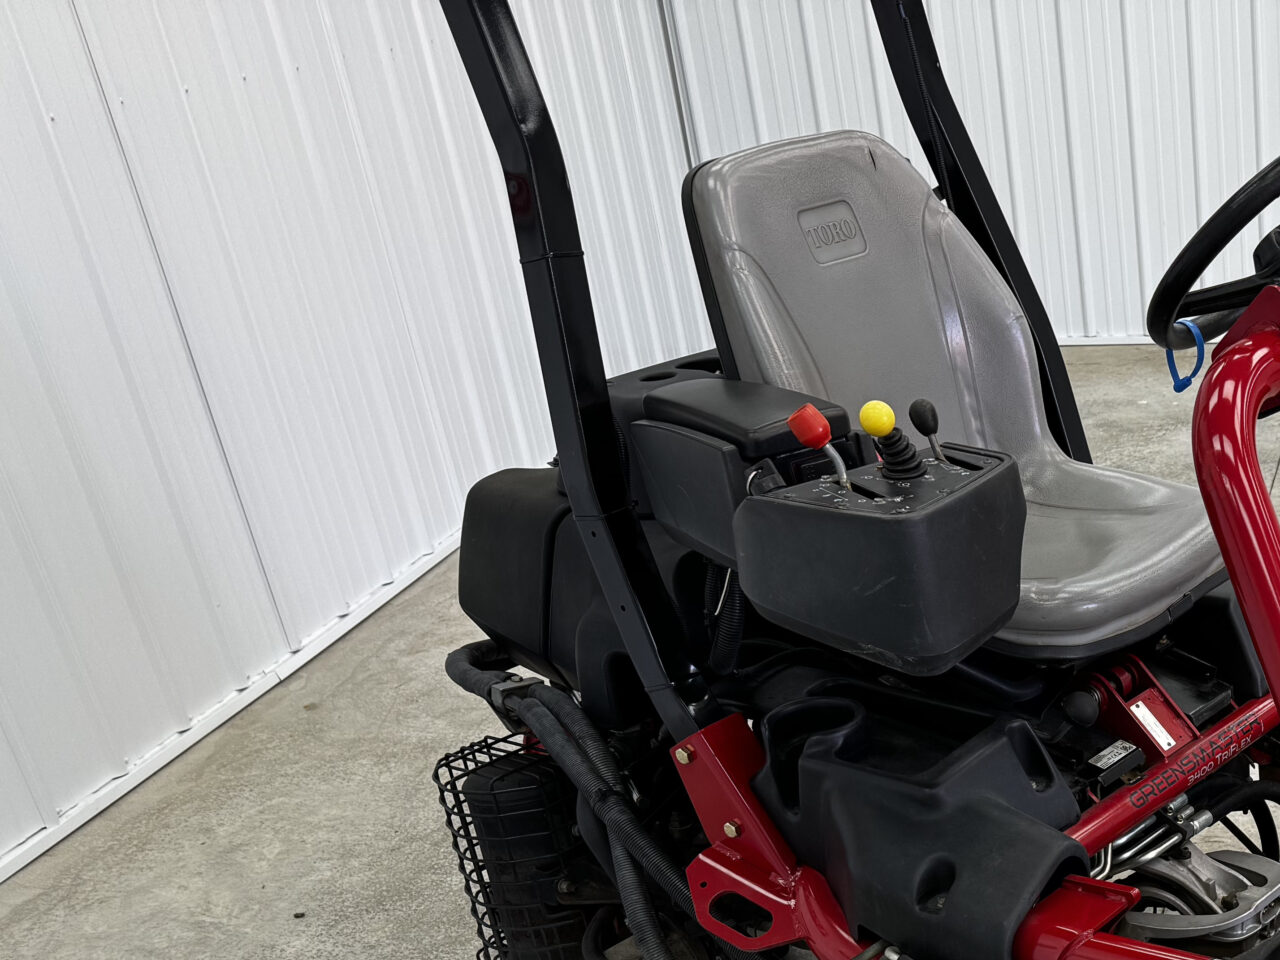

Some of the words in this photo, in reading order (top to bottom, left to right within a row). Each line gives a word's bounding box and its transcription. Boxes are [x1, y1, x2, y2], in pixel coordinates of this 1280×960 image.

[806, 217, 857, 249] TORO
[1129, 713, 1260, 808] GREENSMASTER
[1187, 761, 1214, 786] 3400
